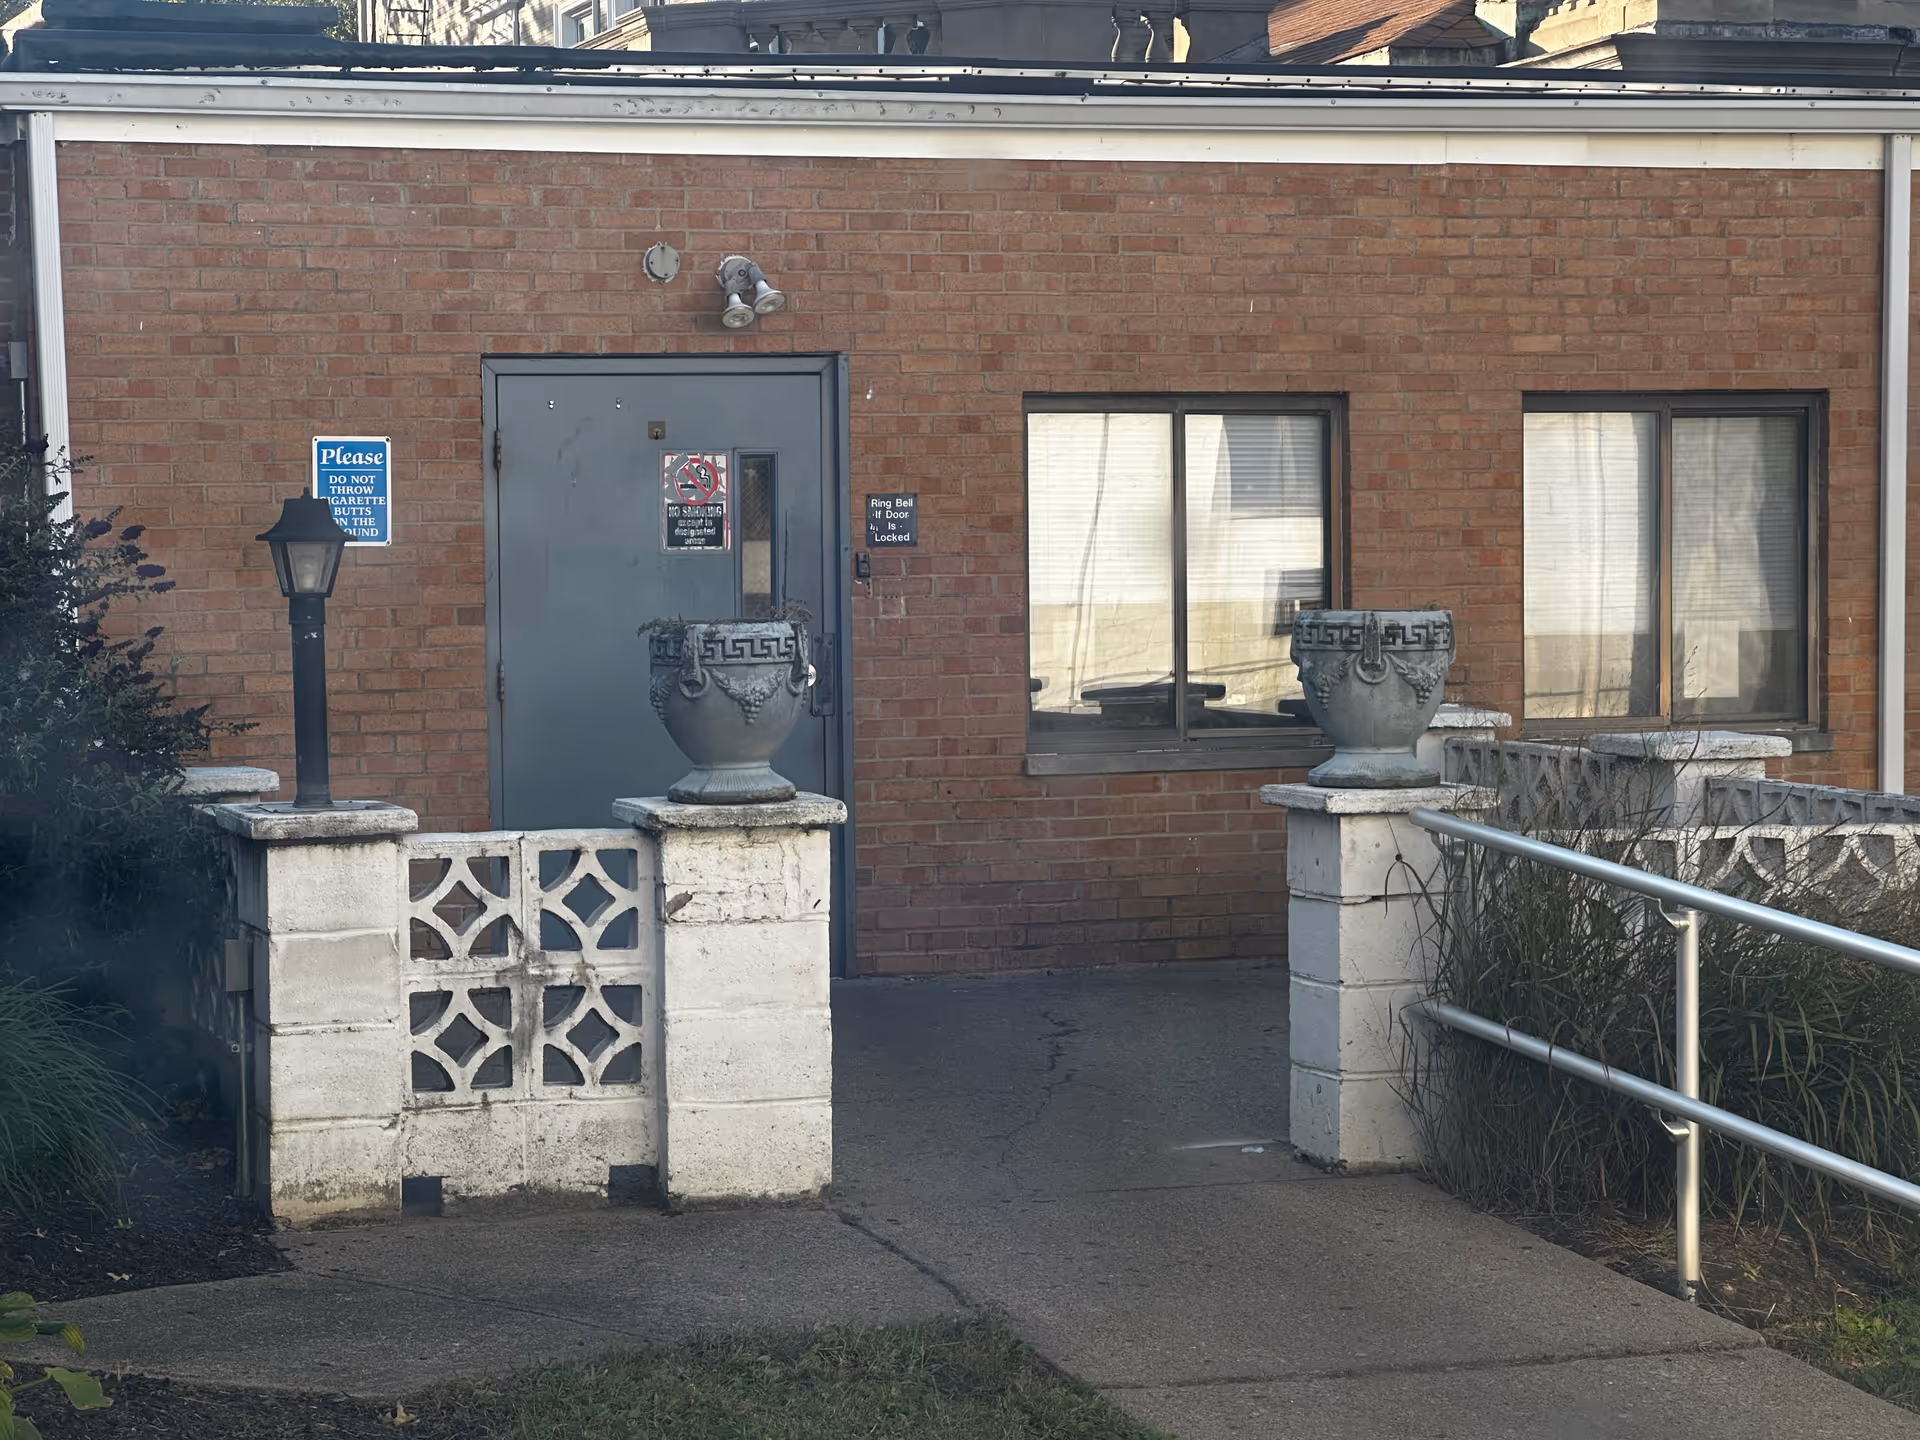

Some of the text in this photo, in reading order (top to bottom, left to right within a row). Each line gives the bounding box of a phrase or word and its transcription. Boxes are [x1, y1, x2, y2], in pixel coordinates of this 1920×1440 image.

[320, 446, 384, 465] Please
[329, 475, 376, 484] DO NOT
[329, 486, 374, 494] THROW
[320, 496, 386, 505] IGARETTE
[871, 498, 913, 509] Ring Bell
[334, 507, 372, 515] BUTTS
[668, 506, 722, 517] NO SMOKING
[875, 510, 909, 519] If Door
[352, 517, 376, 526] THE
[677, 518, 713, 528] except in
[888, 522, 896, 530] Is
[674, 528, 716, 537] designated
[874, 533, 910, 542] Locked
